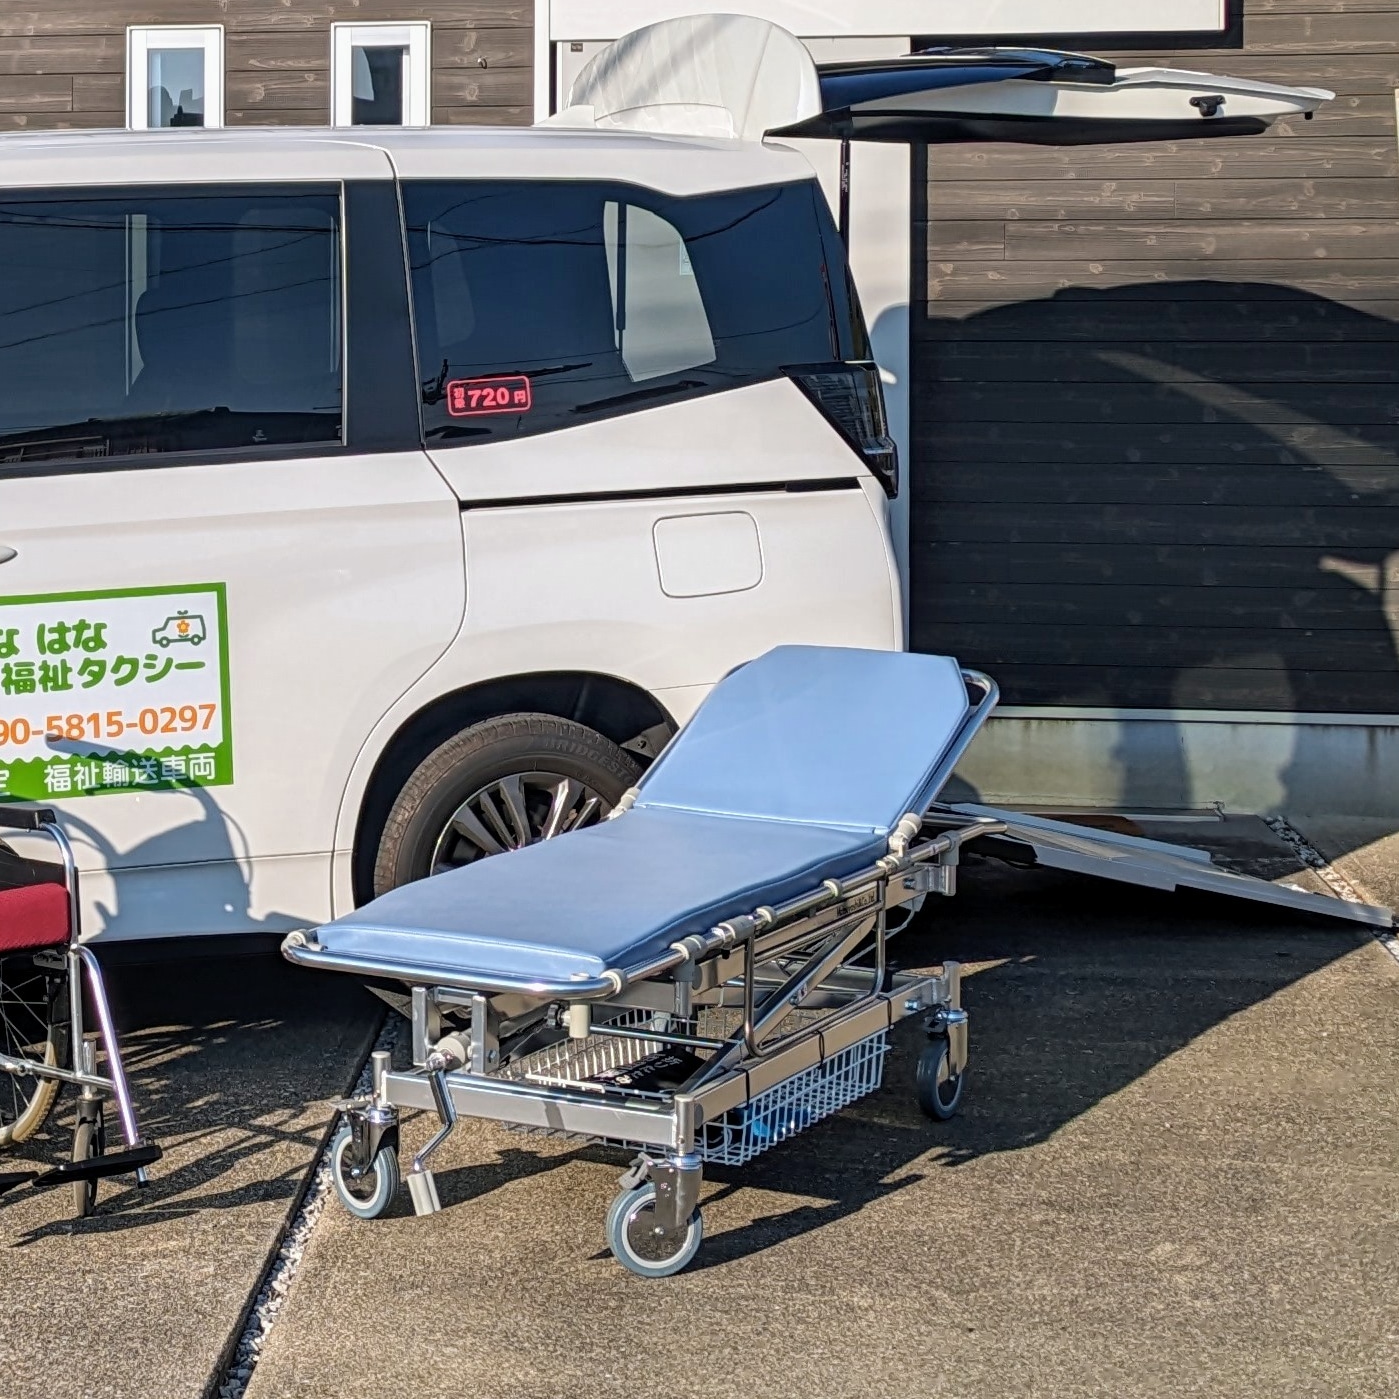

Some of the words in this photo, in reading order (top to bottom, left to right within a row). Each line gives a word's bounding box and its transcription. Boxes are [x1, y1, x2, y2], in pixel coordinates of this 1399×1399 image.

[468, 387, 510, 408] 720
[514, 390, 526, 404] 円
[36, 618, 108, 655] はな
[0, 653, 206, 696] 福祉タクシー
[43, 751, 216, 794] 福祉輸送車両
